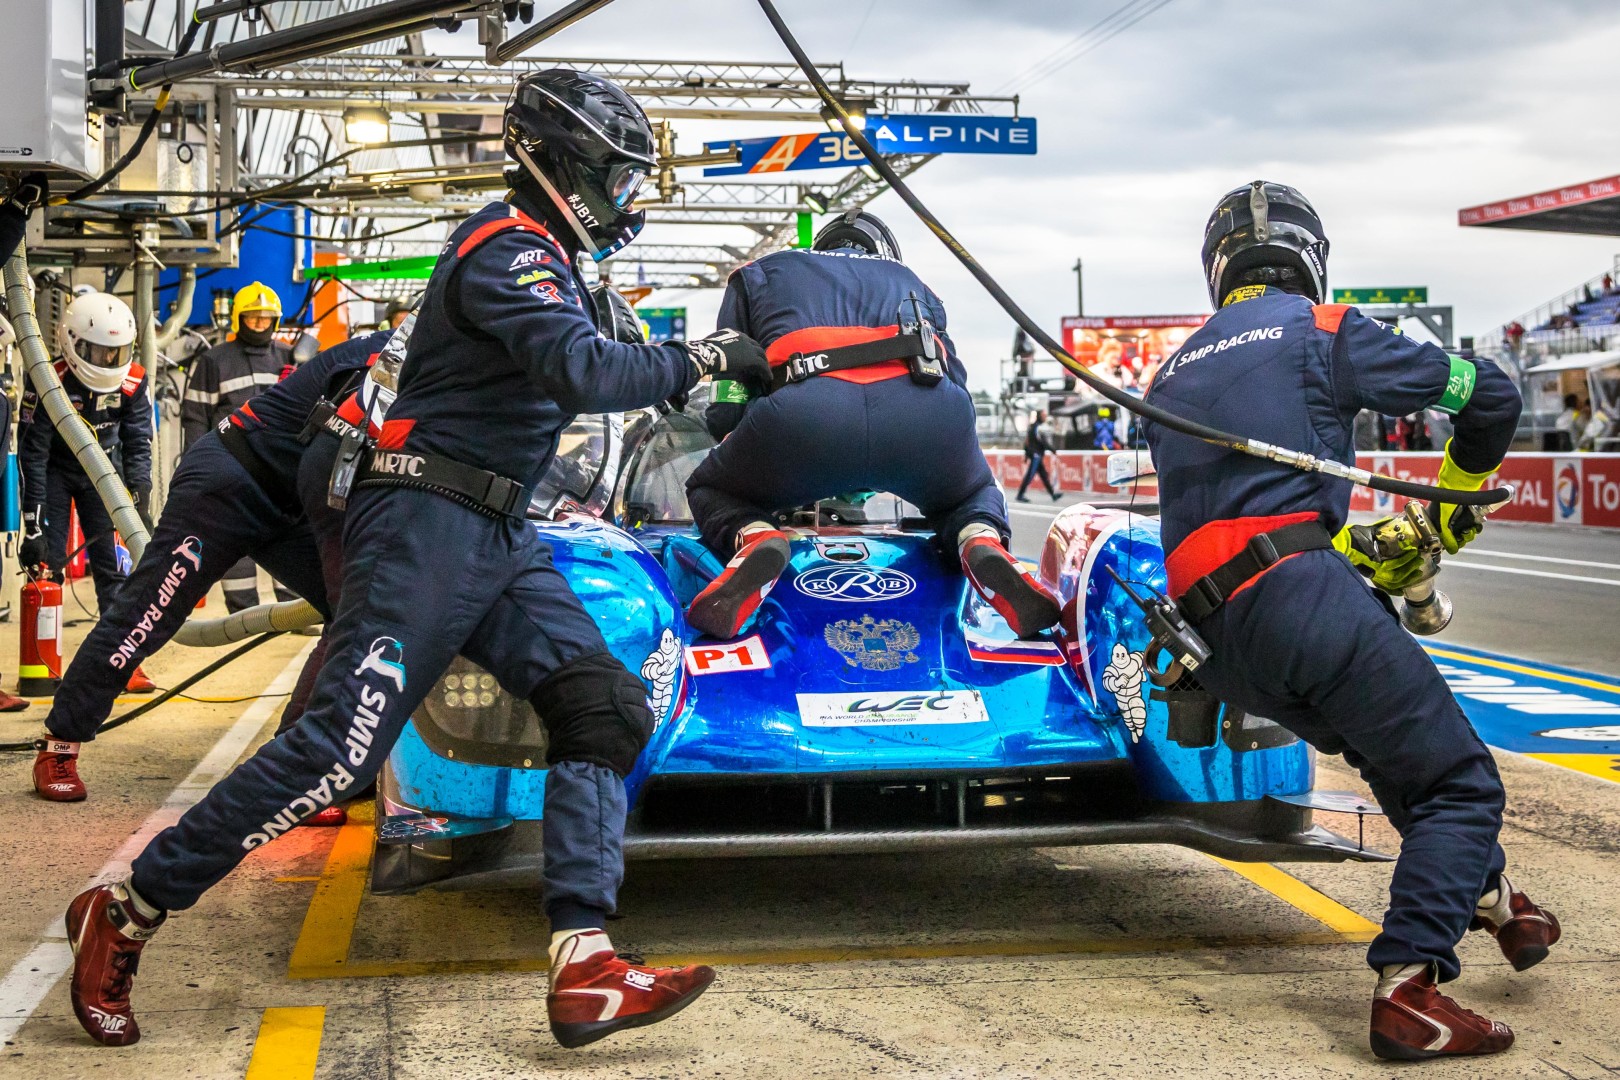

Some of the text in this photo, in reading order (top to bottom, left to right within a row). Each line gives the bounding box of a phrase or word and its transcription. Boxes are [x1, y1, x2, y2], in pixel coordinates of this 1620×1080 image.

[876, 125, 1029, 144] ALPINE
[567, 193, 600, 228] #JB17
[1483, 206, 1504, 218] TOTAL
[1508, 201, 1530, 212] TOTAL
[1533, 195, 1556, 207] TOTAL
[1560, 189, 1584, 201] TOTAL
[1588, 183, 1614, 195] TOTAL
[1177, 326, 1284, 367] SMP RACING
[370, 452, 427, 477] MRTC
[109, 561, 187, 670] SMP RACING
[692, 646, 754, 670] P1
[847, 696, 954, 712] WEC
[241, 685, 386, 851] SMP RACING
[625, 971, 655, 987] OMP
